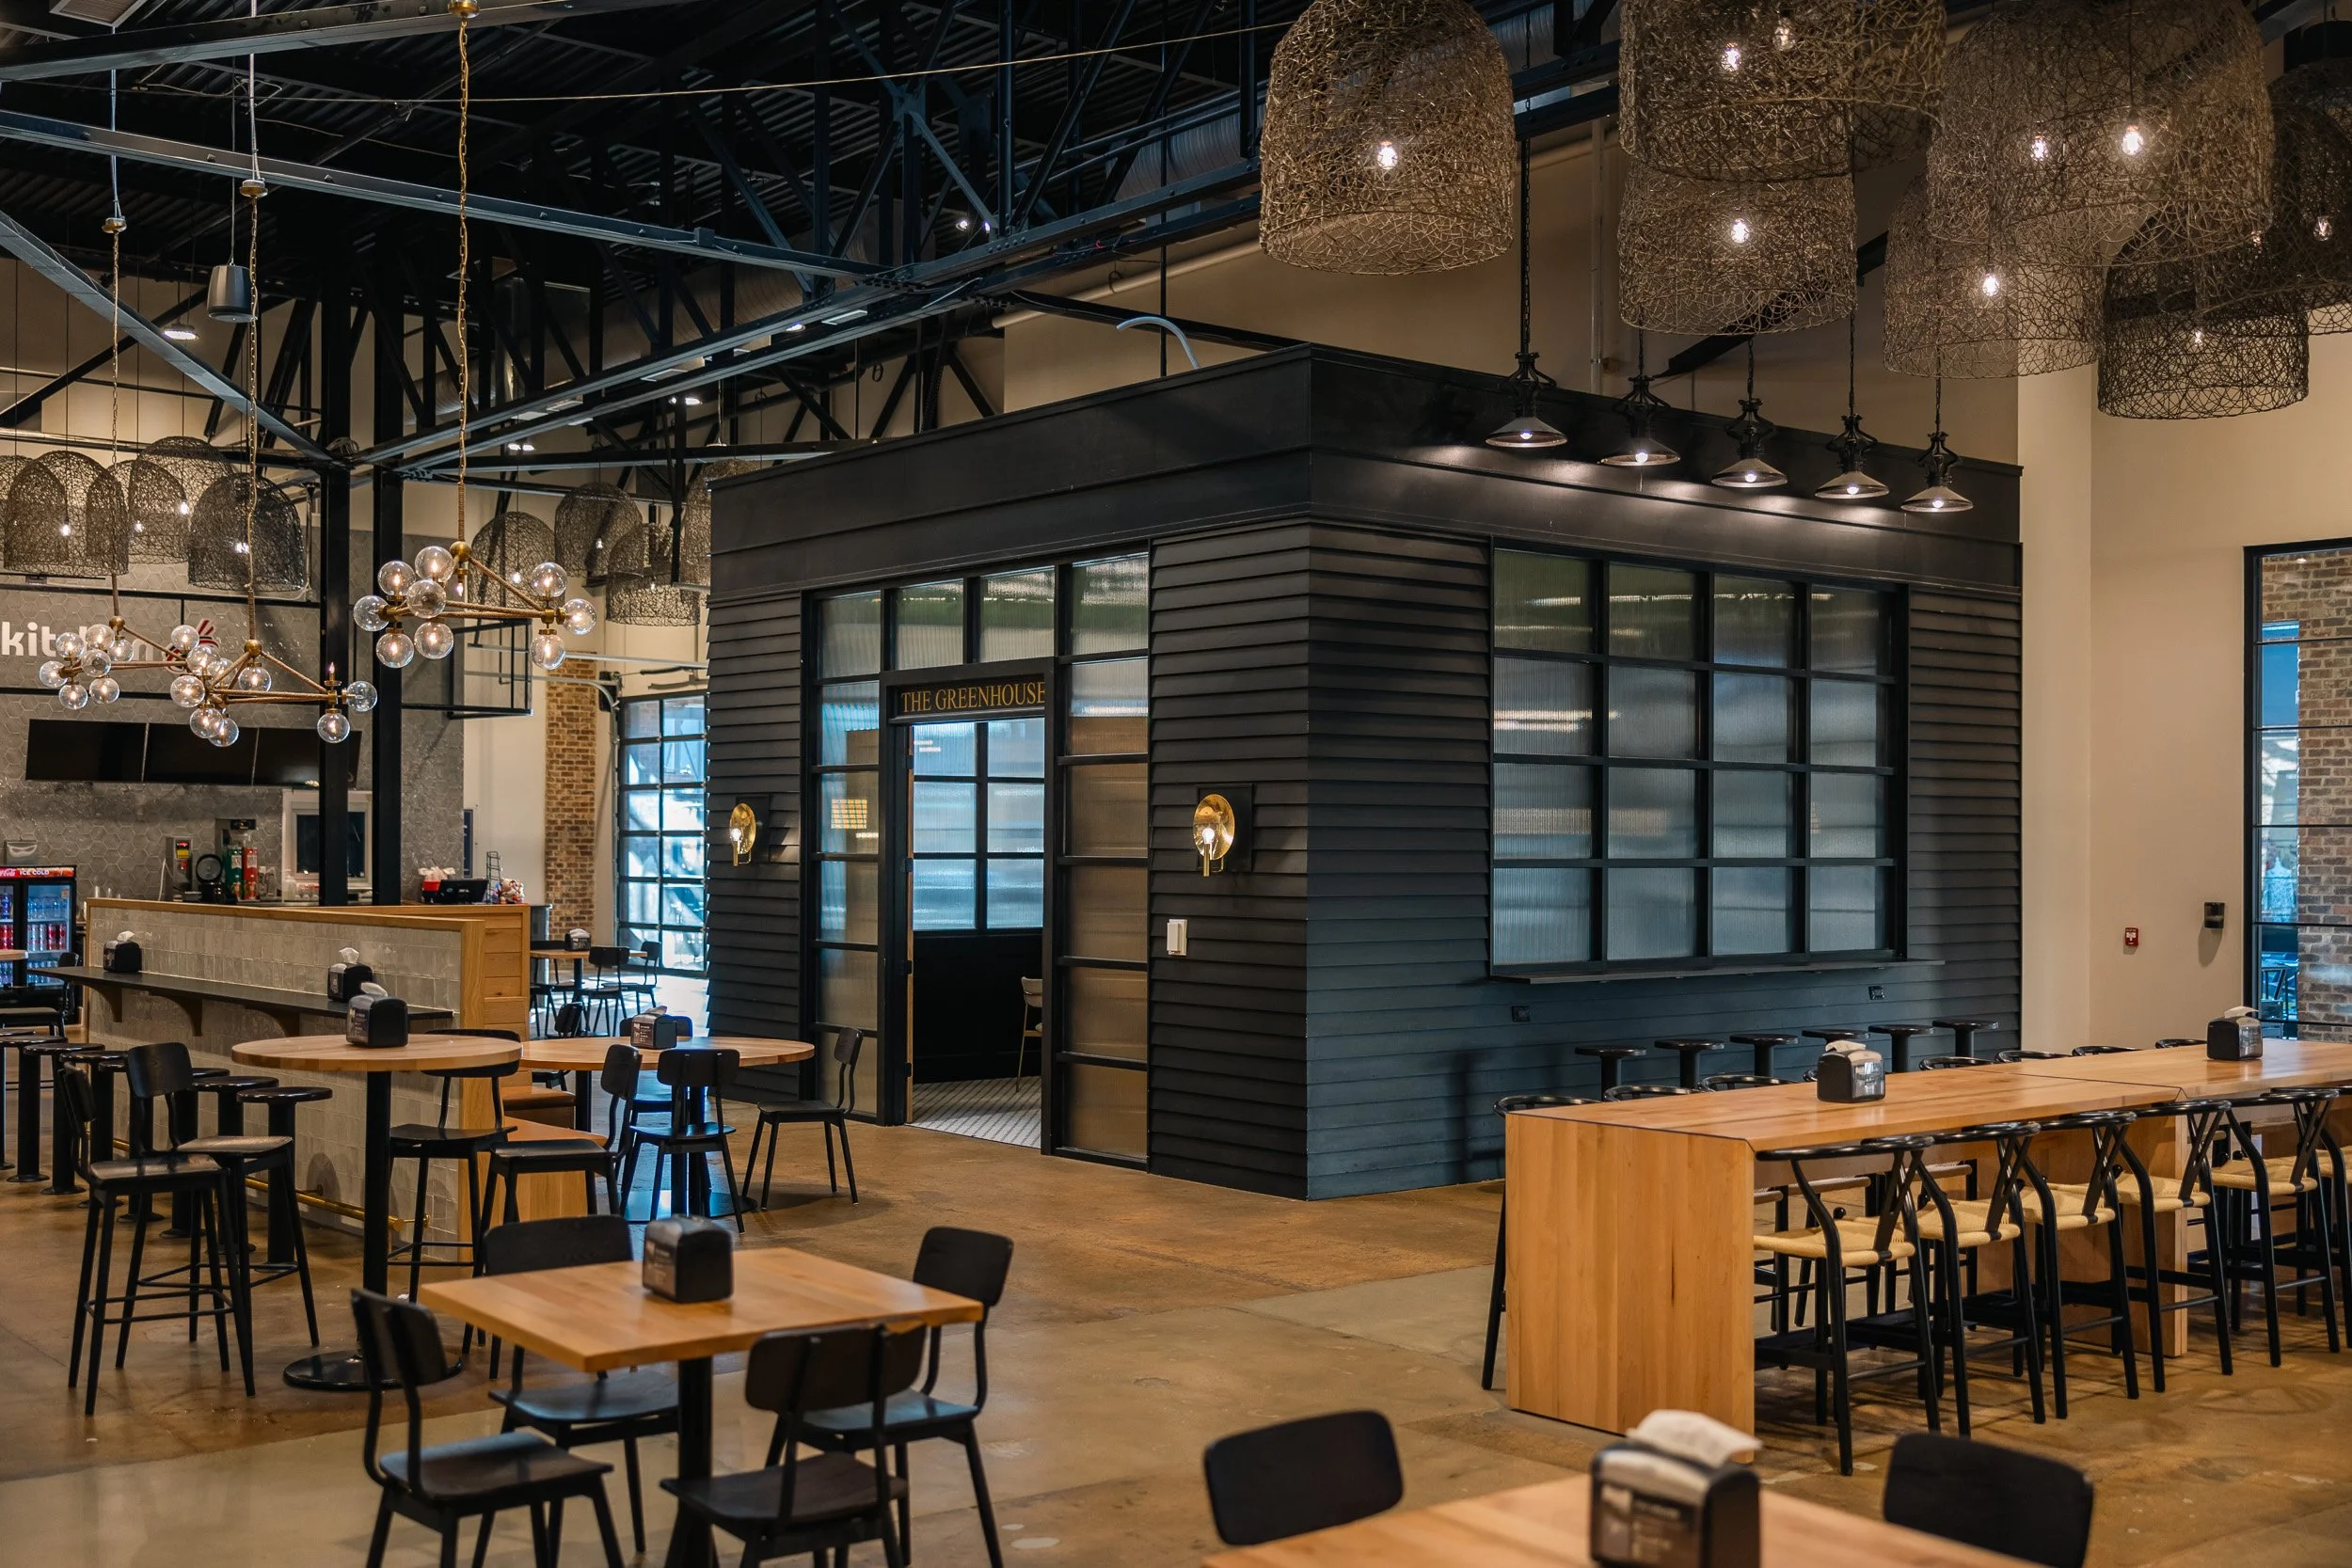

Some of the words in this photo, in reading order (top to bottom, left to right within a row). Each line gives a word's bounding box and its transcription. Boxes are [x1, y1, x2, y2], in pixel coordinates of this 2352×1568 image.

[1, 622, 153, 660] kitn
[901, 690, 931, 713] THE
[935, 682, 1046, 710] GREENHOUSE
